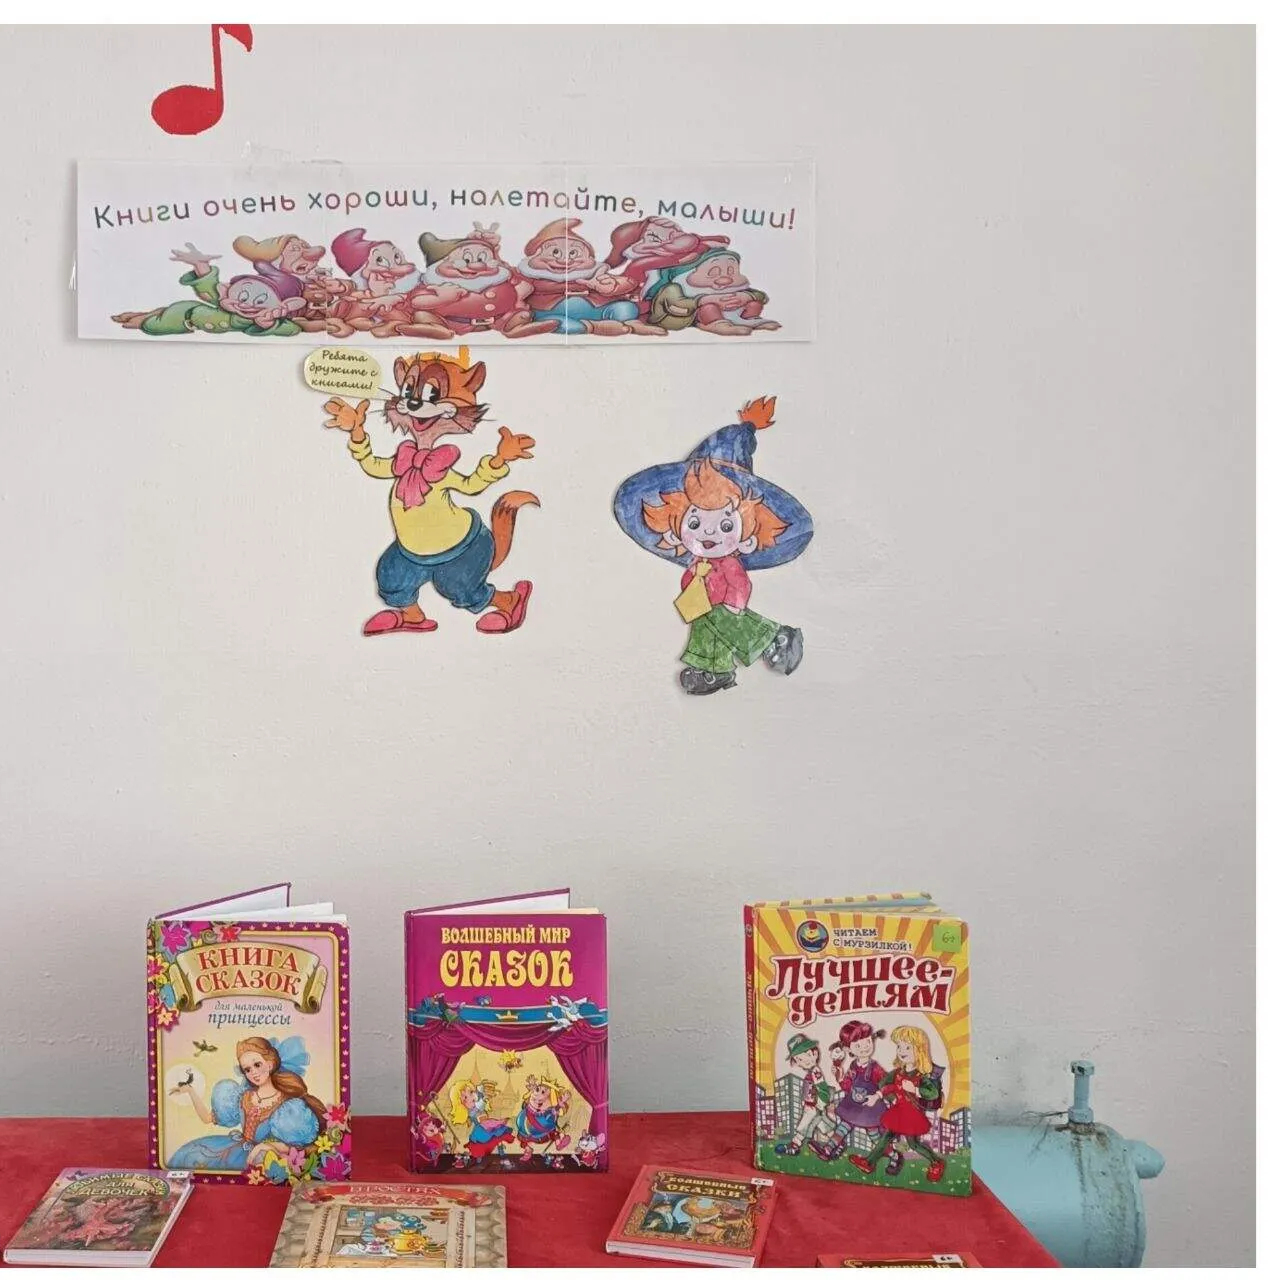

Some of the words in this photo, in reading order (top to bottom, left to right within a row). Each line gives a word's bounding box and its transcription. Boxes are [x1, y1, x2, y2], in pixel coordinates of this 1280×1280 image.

[94, 201, 190, 229] Книги
[203, 194, 296, 217] очень
[307, 188, 438, 216] хороши,
[450, 187, 644, 219] налетайте,
[657, 200, 796, 230] малыши!
[322, 349, 368, 362] Ребята
[309, 362, 368, 376] дружите
[311, 379, 373, 390] книгами!
[441, 924, 536, 944] ВОЛШЕБНЫЙ
[539, 927, 571, 944] МИР
[833, 928, 877, 937] ЧИТАЕМ
[843, 939, 913, 951] МУРЗИЛКОЙ!
[197, 946, 300, 973] КНИГА
[440, 949, 574, 987] СКАЗОК
[195, 969, 302, 996] СКАЗОК
[214, 1001, 231, 1010] для
[233, 1002, 283, 1012] маленькой
[791, 983, 948, 1024] детям
[208, 1013, 292, 1029] принцессы
[666, 1184, 741, 1198] СКАЗКИ
